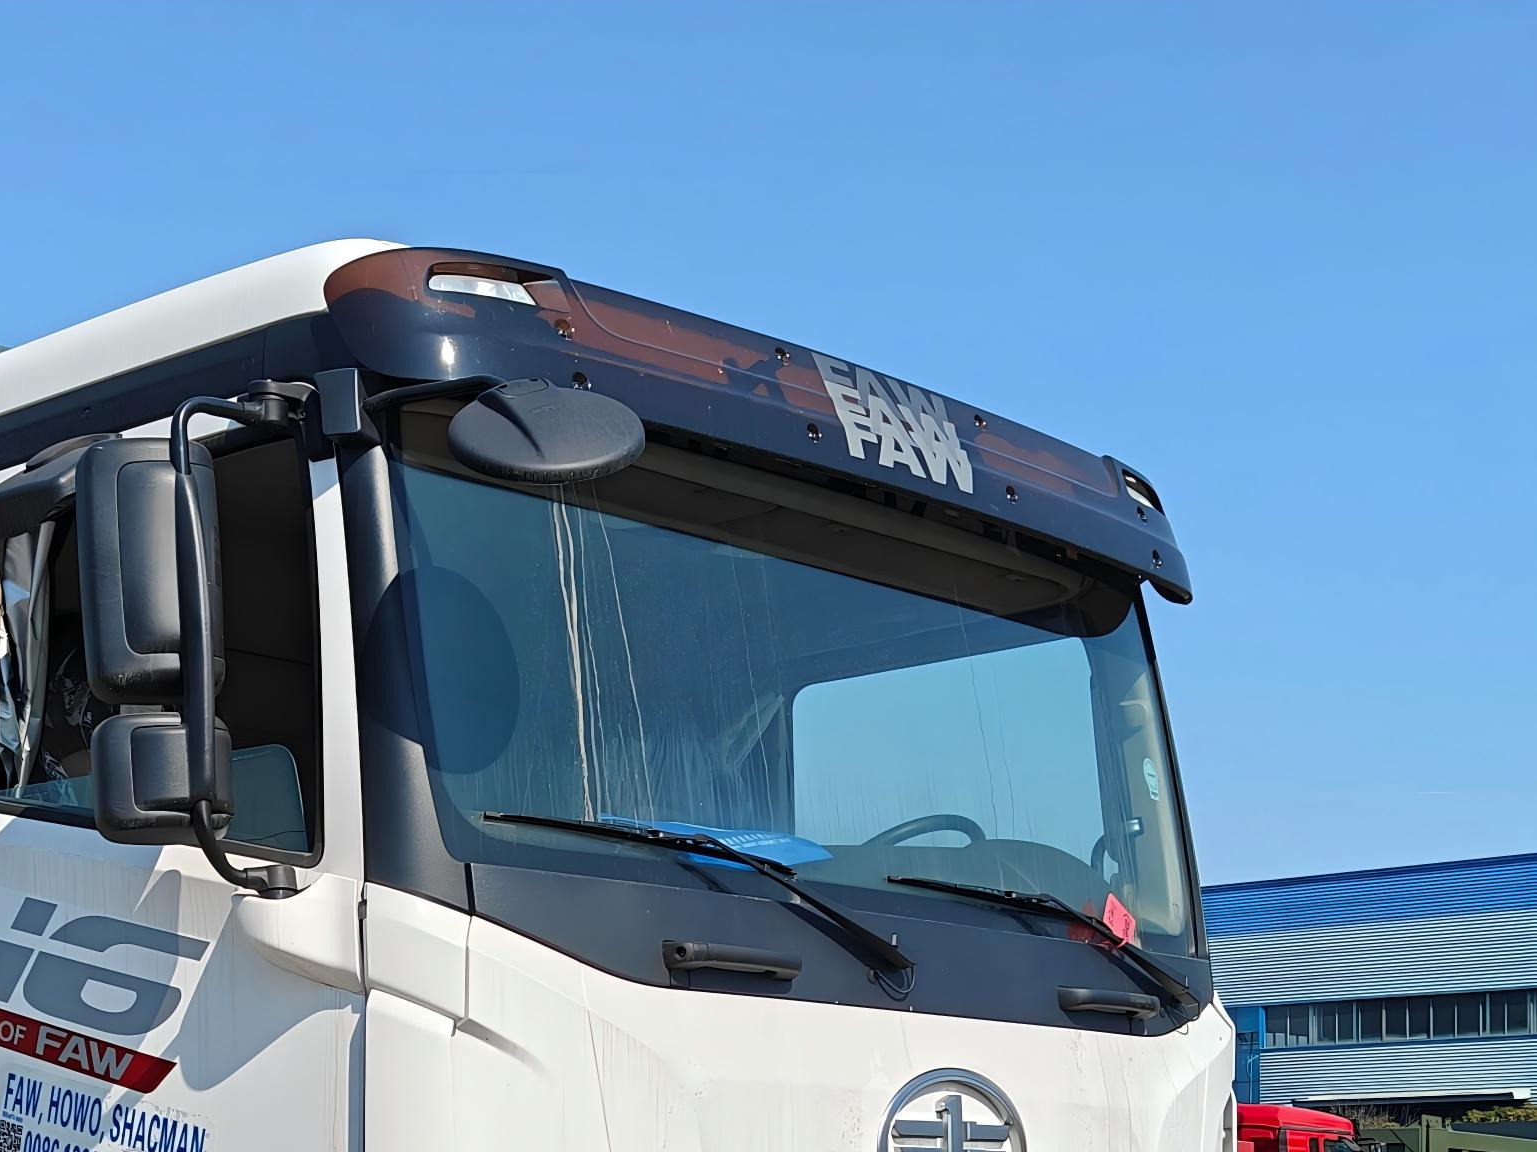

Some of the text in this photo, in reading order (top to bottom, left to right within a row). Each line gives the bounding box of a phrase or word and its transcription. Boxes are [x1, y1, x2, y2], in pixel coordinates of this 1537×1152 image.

[828, 388, 974, 494] FAW
[35, 1025, 133, 1080] FAW
[3, 1072, 43, 1126] FAW,
[47, 1085, 105, 1144] HOWO,
